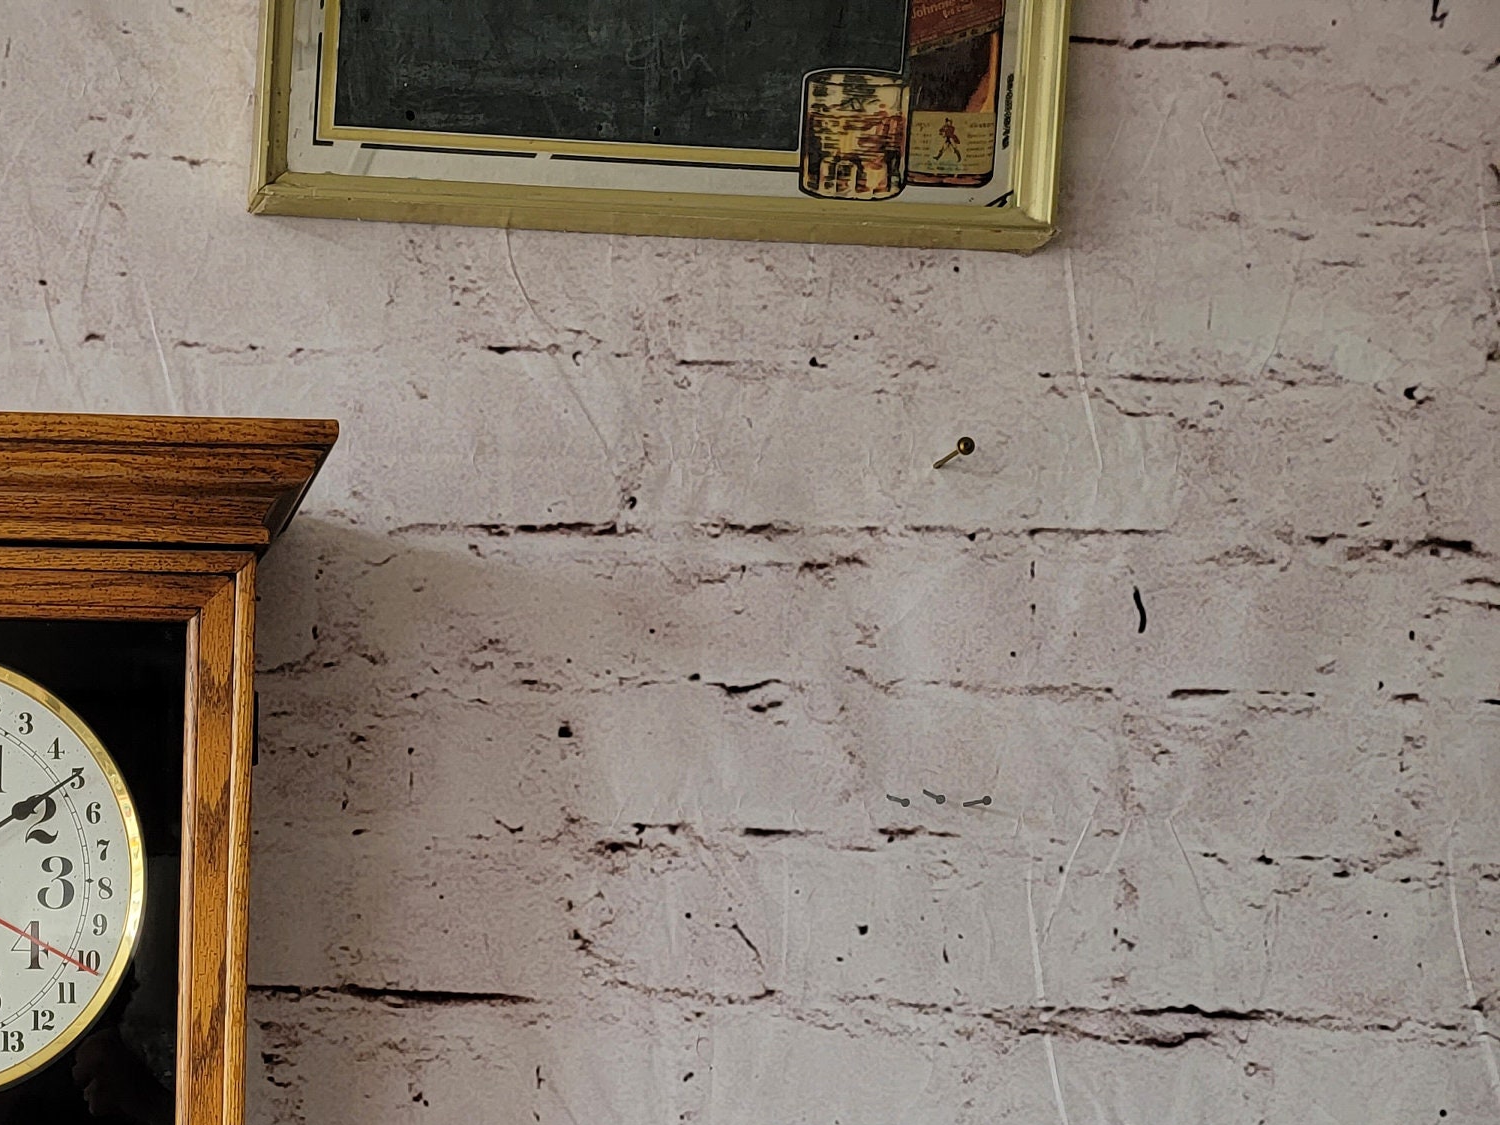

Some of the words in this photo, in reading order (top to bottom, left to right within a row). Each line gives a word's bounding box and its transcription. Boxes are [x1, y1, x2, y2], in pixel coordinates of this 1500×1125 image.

[18, 712, 34, 735] 3
[46, 737, 66, 760] 4
[68, 766, 86, 790] 5
[25, 793, 59, 845] 2
[85, 801, 101, 825] 6
[96, 839, 111, 861] 7
[37, 855, 75, 910] 3
[98, 876, 113, 900] 8
[92, 913, 108, 936] 9
[8, 920, 51, 970] 4
[75, 949, 101, 975] 10
[57, 981, 77, 1004] 11
[31, 1009, 55, 1031] 12
[1, 1030, 25, 1053] 13
